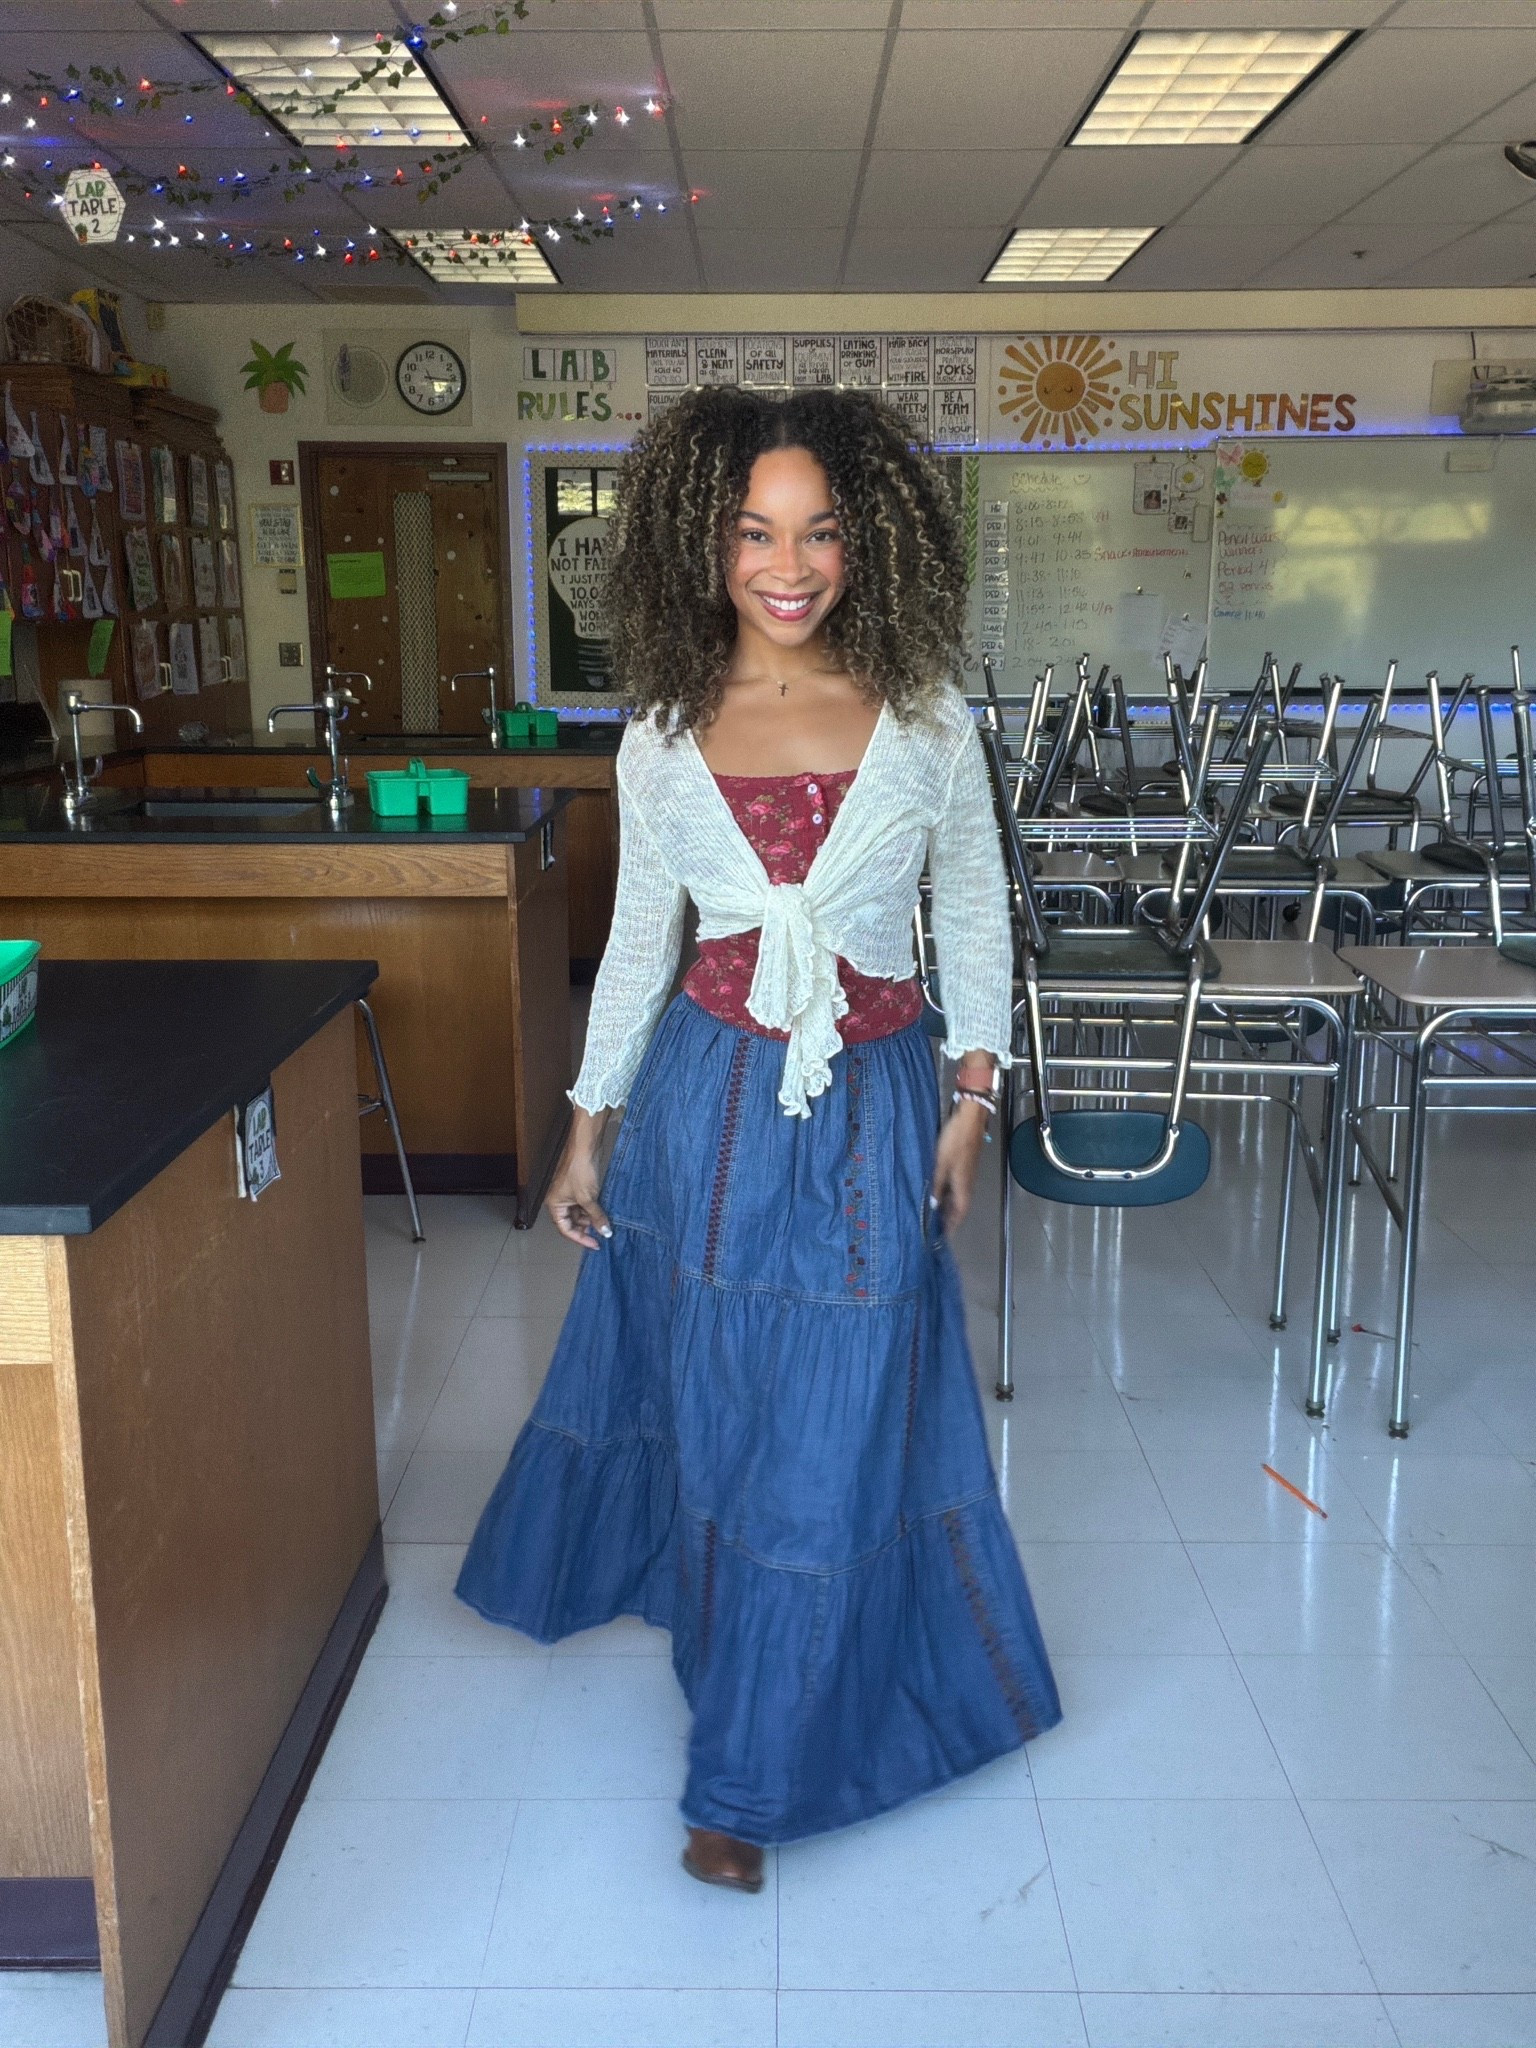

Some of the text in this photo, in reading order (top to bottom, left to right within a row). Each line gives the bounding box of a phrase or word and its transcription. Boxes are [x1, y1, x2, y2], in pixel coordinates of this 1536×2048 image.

[75, 180, 106, 198] LAB
[68, 197, 117, 216] TABLE
[92, 218, 101, 234] 2
[908, 339, 928, 347] BACK
[415, 354, 423, 362] 11
[425, 350, 434, 359] 12
[646, 349, 687, 358] MATERIALS
[697, 348, 727, 358] CLEAN
[406, 363, 417, 371] 10
[446, 363, 452, 372] 2
[531, 349, 610, 381] LAB
[711, 359, 734, 369] NEAT
[745, 359, 784, 370] SAFETY
[855, 359, 875, 368] GUM
[937, 364, 974, 375] JOKES
[1129, 350, 1179, 390] HI
[404, 374, 411, 382] 9
[816, 374, 833, 384] LAB
[905, 371, 926, 383] FIRE
[409, 385, 415, 394] 8
[417, 393, 423, 403] 7
[428, 397, 435, 406] 6
[649, 395, 675, 404] FOLLOW
[897, 392, 919, 403] WEAR
[944, 391, 963, 403] BE A
[940, 403, 969, 415] TEAM
[1119, 391, 1357, 432] SUNSHINES
[948, 425, 972, 434] your
[987, 522, 1001, 530] PER
[558, 538, 567, 556] I
[551, 558, 579, 571] NOT
[560, 575, 565, 585] I
[569, 574, 592, 584] JUST
[570, 601, 595, 609] WAYS
[985, 606, 1000, 615] PER
[981, 641, 997, 650] PER
[252, 1107, 267, 1137] LAB
[249, 1129, 271, 1164] TABLE
